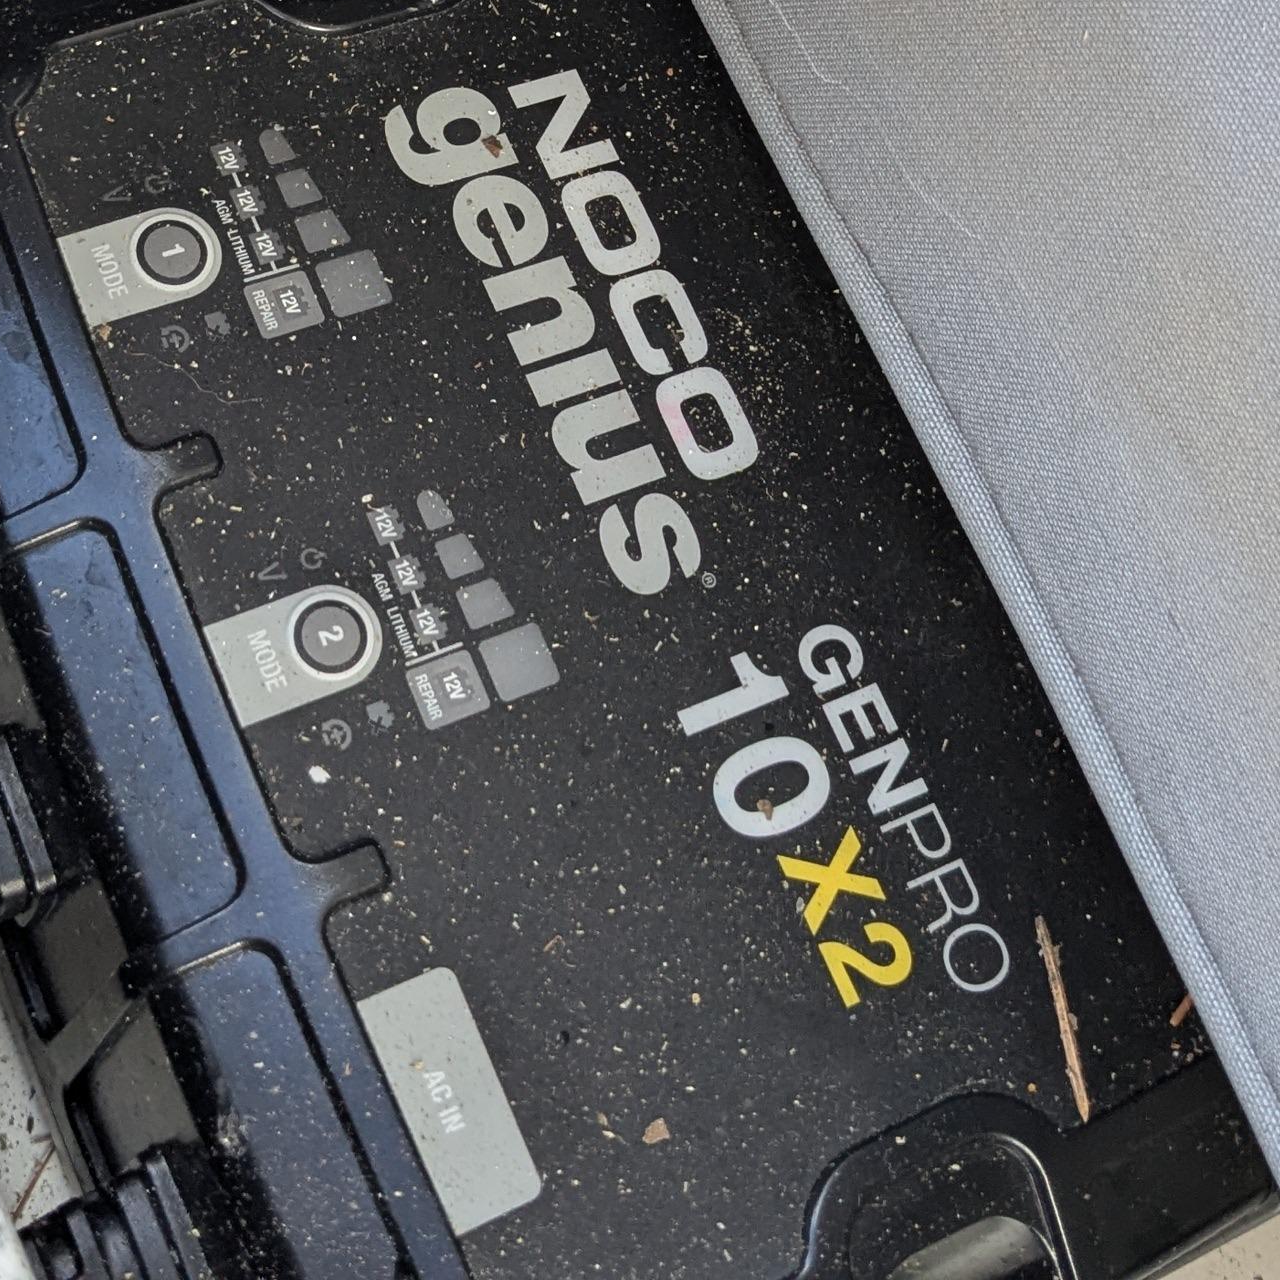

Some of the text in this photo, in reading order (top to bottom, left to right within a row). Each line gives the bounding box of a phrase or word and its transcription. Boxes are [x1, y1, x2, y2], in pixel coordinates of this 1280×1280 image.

[218, 146, 240, 170] 12V
[236, 189, 259, 214] 12V
[162, 243, 185, 257] 1
[211, 199, 255, 277] AGM LITHIUM
[255, 232, 277, 258] 12V
[90, 243, 129, 300] MODE
[507, 68, 759, 480] NOCO
[251, 288, 278, 331] REPAIR
[279, 289, 301, 315] 12V
[384, 86, 702, 596] genius
[374, 511, 398, 538] 12V
[395, 559, 418, 587] 12V
[371, 572, 418, 659] AGM LITHIUM
[417, 608, 439, 636] 12V
[318, 625, 345, 647] 2
[247, 629, 288, 693] MODE
[414, 672, 442, 721] REPAIR
[442, 671, 466, 700] 12V
[798, 624, 1010, 992] GENPRO
[423, 1071, 466, 1134] AC IN
